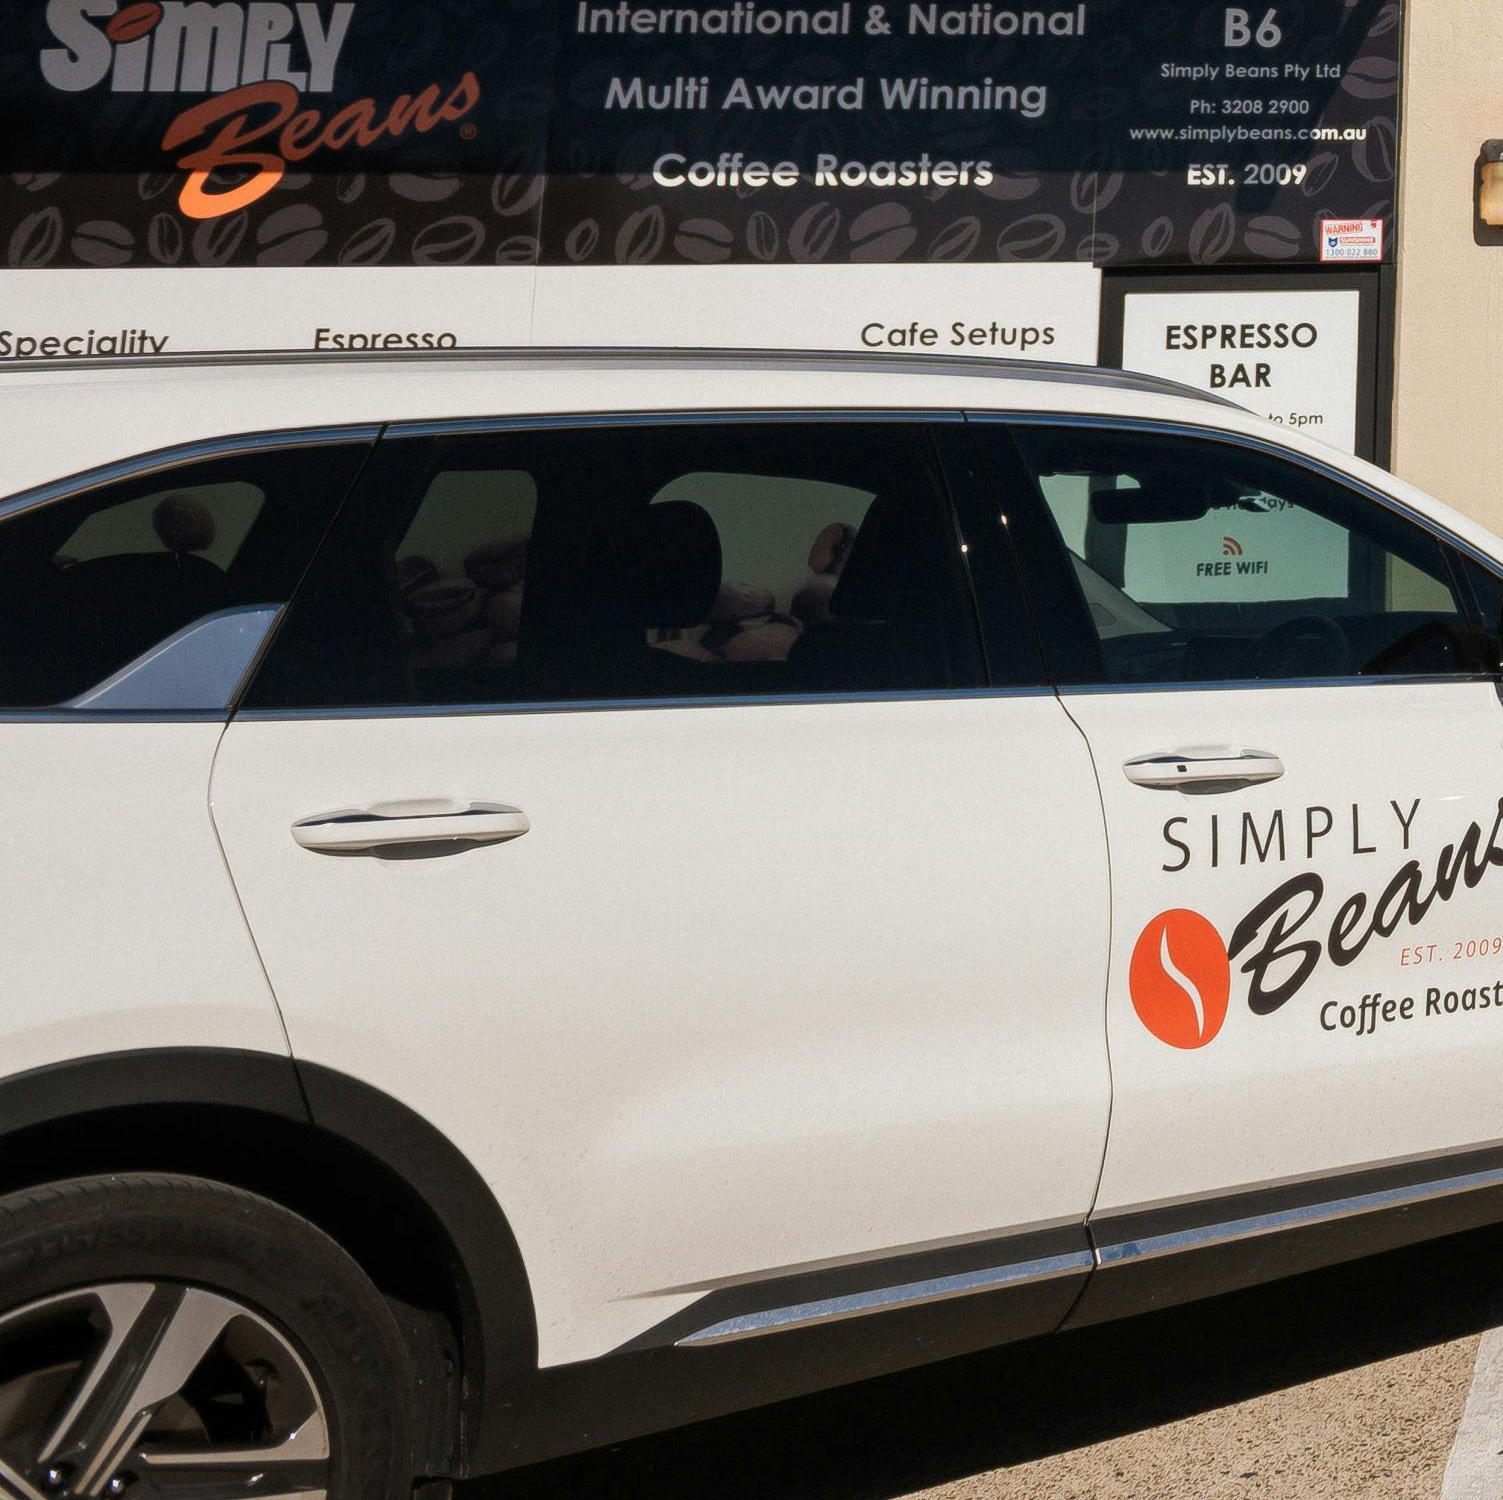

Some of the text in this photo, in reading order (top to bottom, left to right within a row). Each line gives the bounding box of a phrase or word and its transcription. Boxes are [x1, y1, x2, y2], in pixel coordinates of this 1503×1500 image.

[576, 1, 1086, 36] International & National
[1224, 7, 1282, 48] B6
[1160, 62, 1341, 82] Simply Beans Pty Ltd
[604, 77, 1047, 118] Multi Award Winning
[1190, 99, 1310, 115] Ph: 3208 2900
[161, 70, 481, 220] Beans
[1129, 125, 1367, 143] www.simplybeans.com.au
[652, 153, 994, 188] Coffee Roasters
[1187, 164, 1307, 186] EST. 2009
[1325, 222, 1363, 236] WARNING
[314, 327, 458, 350] Espresso
[860, 321, 1056, 352] Cafe Setups
[1165, 322, 1318, 350] ESPRESSO
[1209, 362, 1272, 389] BAR
[1289, 412, 1323, 428] 5pm
[1196, 561, 1232, 577] FREE
[1161, 798, 1422, 873] SIMPLY
[1399, 936, 1503, 967] EST. 2009
[1319, 992, 1415, 1037] Coffee
[1425, 981, 1503, 1017] Roast
